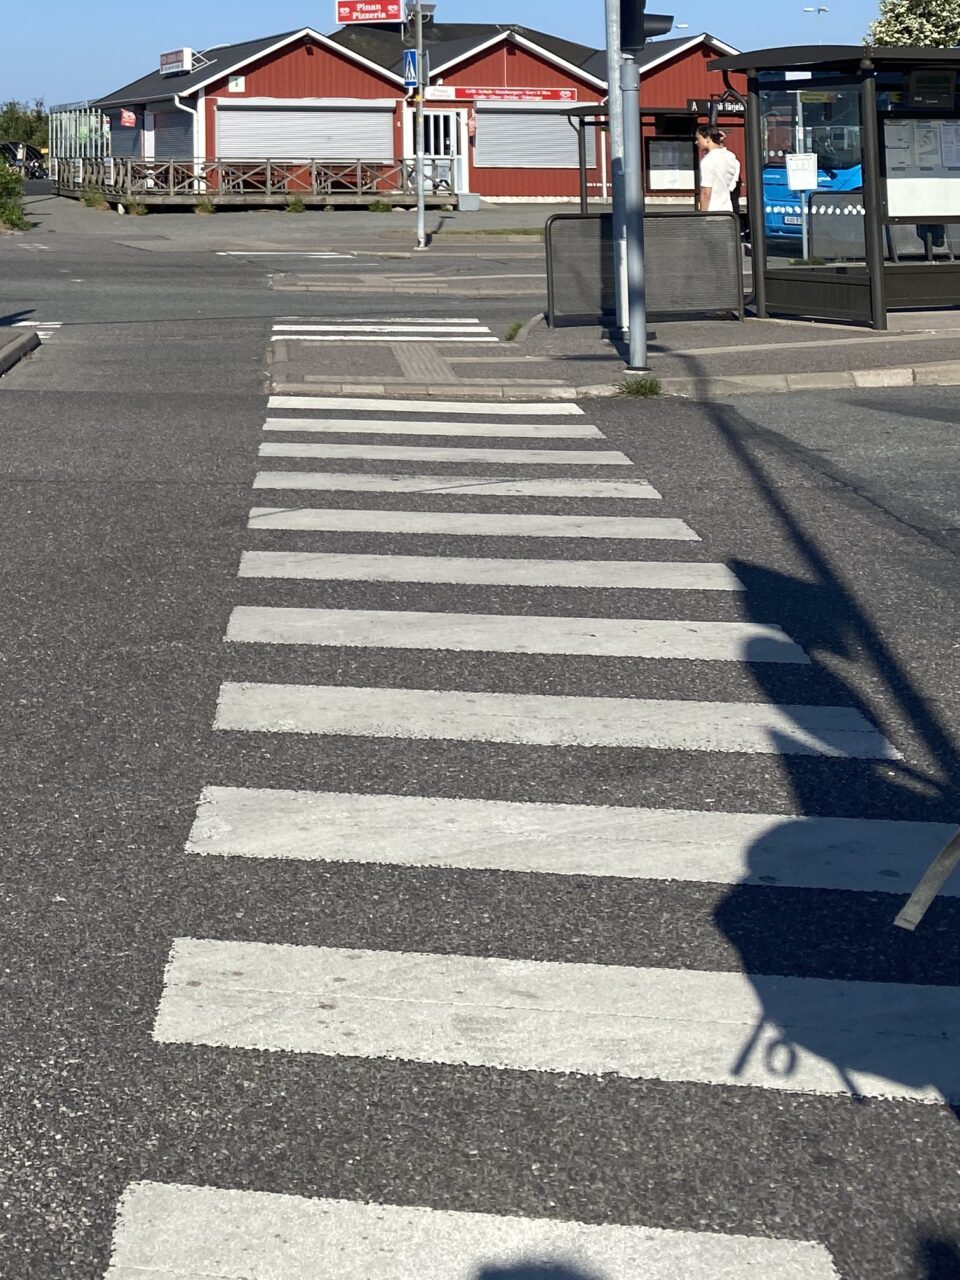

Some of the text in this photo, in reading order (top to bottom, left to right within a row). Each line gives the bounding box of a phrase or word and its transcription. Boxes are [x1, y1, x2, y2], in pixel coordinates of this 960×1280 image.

[356, 3, 381, 11] Pinan
[352, 11, 386, 19] Pizzeria
[691, 101, 698, 111] A
[725, 102, 745, 112] färjelä
